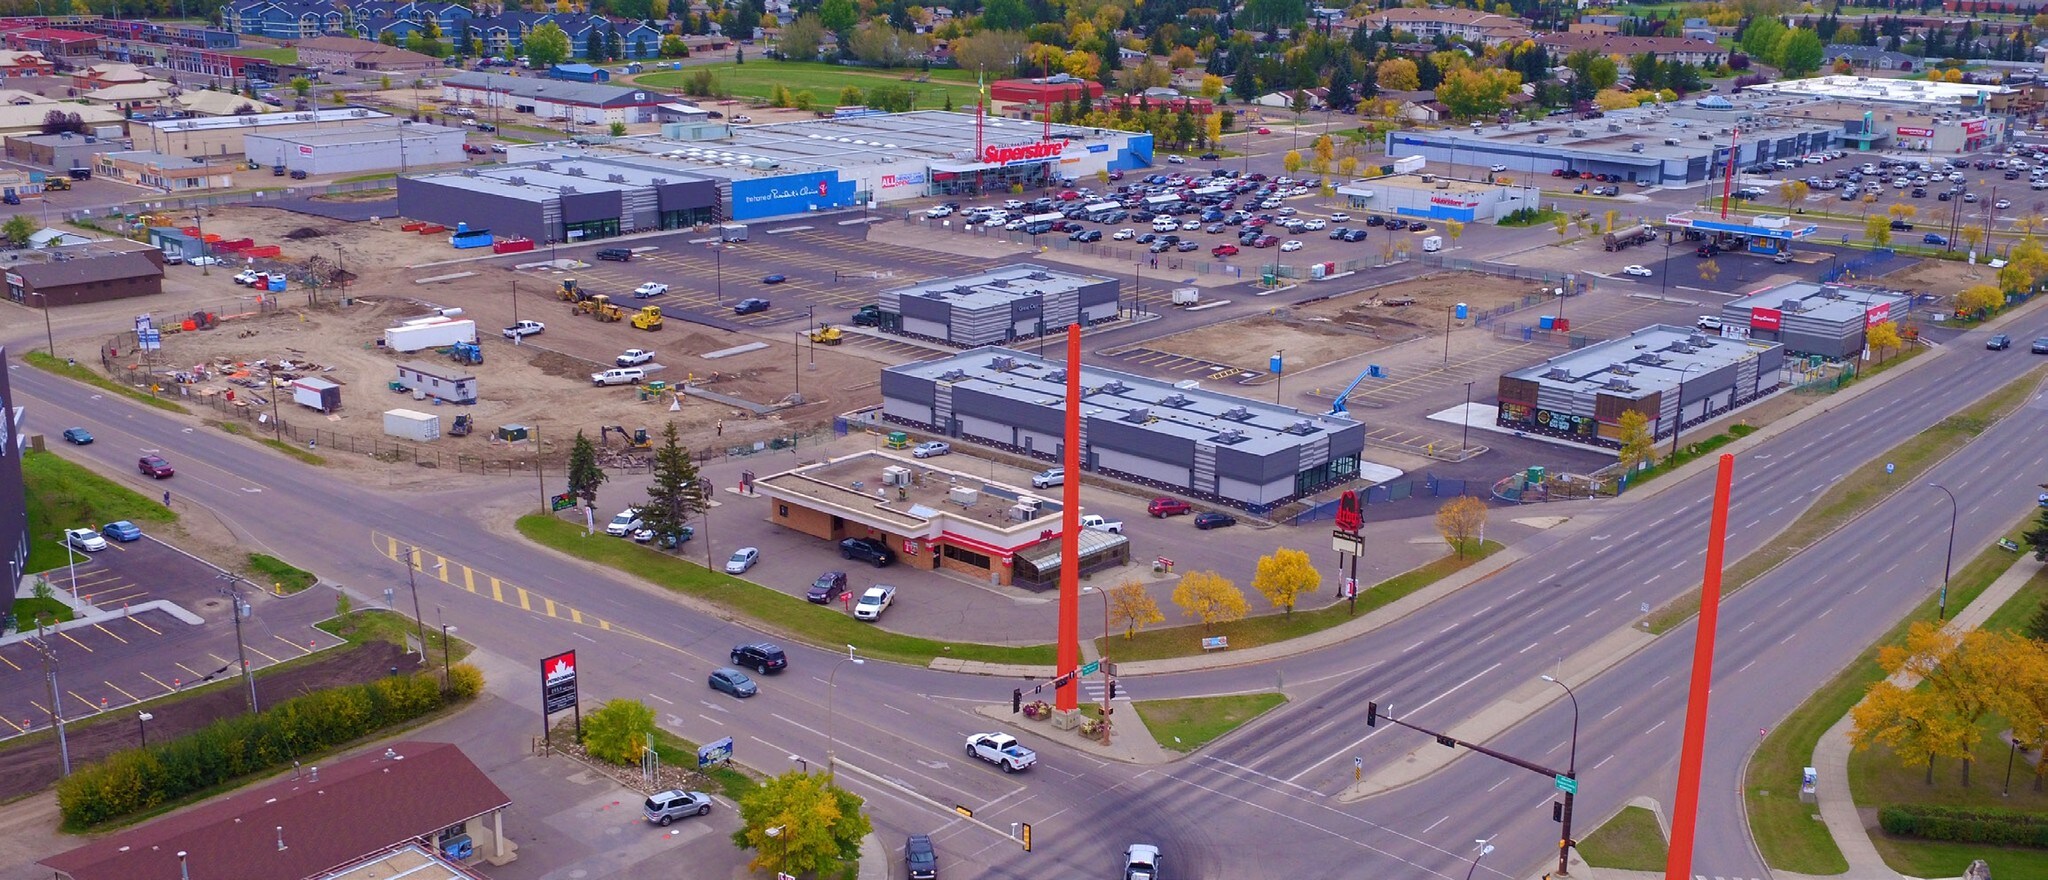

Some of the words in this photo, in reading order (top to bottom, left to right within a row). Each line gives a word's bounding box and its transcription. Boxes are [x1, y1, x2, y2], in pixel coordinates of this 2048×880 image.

[984, 142, 1062, 166] Superstore
[882, 177, 896, 187] ALL
[800, 186, 819, 196] Choice
